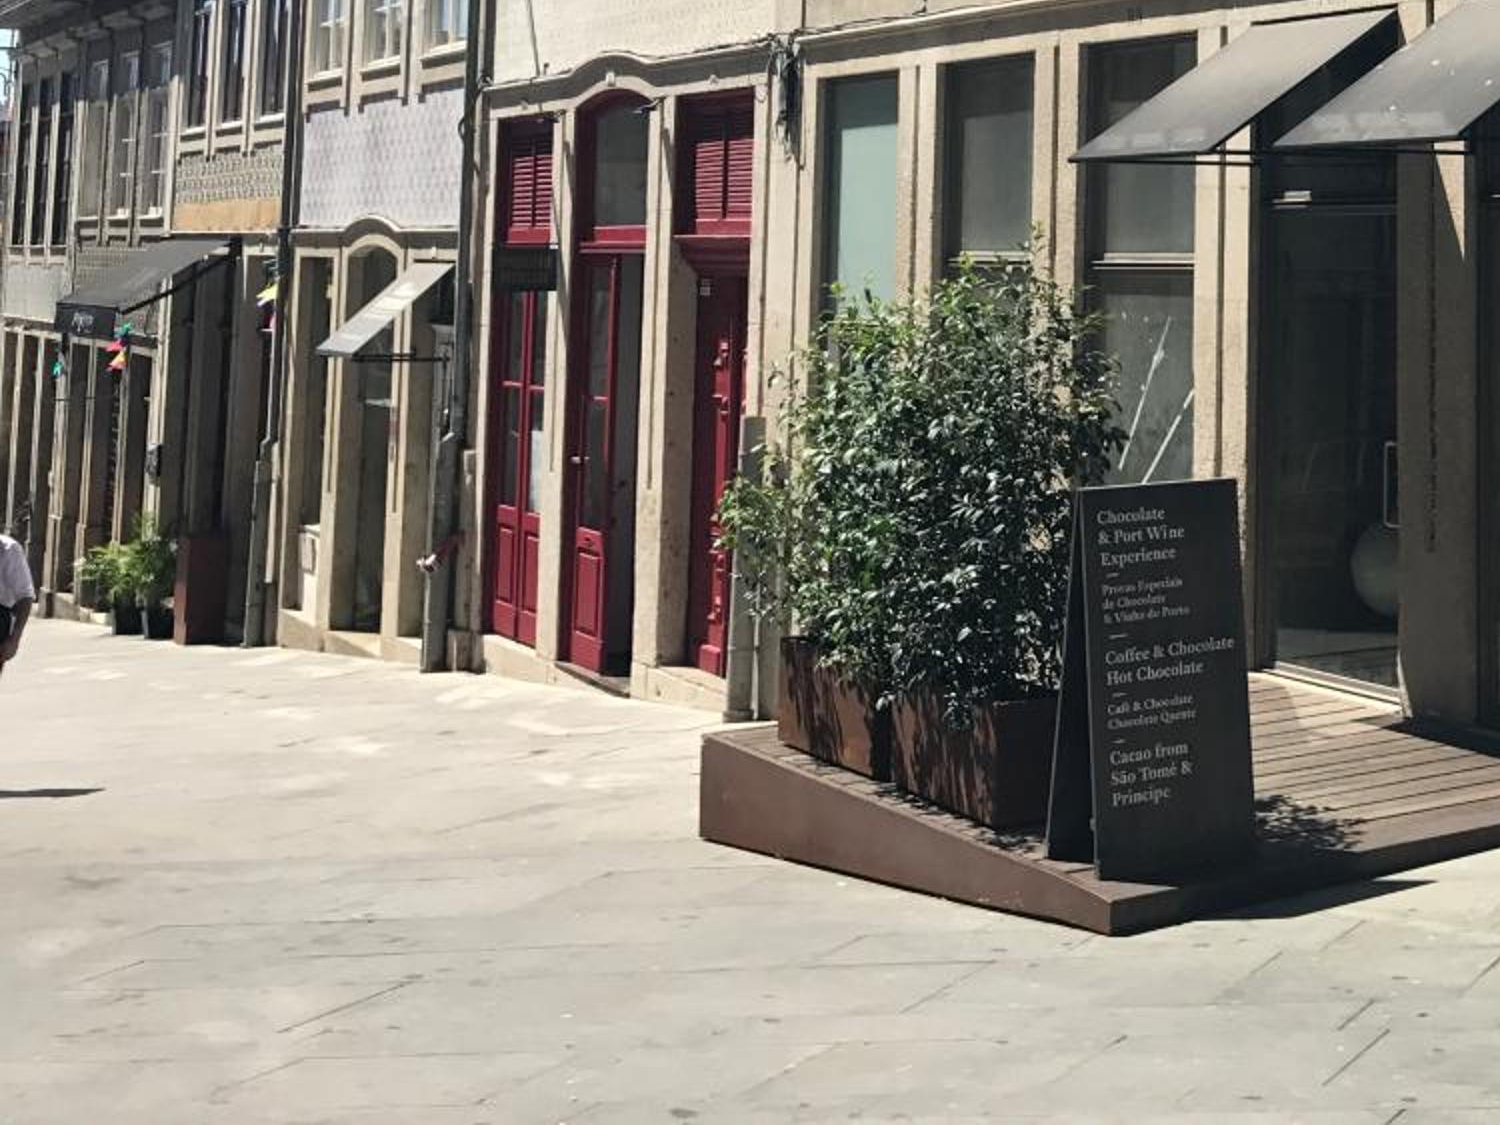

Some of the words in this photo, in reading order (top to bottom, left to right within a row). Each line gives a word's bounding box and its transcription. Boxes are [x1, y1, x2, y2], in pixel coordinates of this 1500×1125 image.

[1097, 507, 1165, 525] Chocolate
[1098, 529, 1110, 544] &
[1114, 527, 1143, 543] Port
[1147, 524, 1184, 540] Wine
[1100, 547, 1177, 568] Experience
[1117, 593, 1165, 608] Chocolate
[1162, 605, 1190, 618] Porto
[1105, 646, 1149, 665] Coffee
[1153, 644, 1165, 658] &
[1168, 636, 1235, 656] Chocolate
[1106, 669, 1133, 686] Hot
[1136, 660, 1204, 681] Chocolate
[1144, 693, 1193, 709] Chocolate
[1107, 714, 1158, 730] Chocolate
[1160, 708, 1196, 724] Quente
[1110, 748, 1151, 766] Cacao
[1155, 742, 1188, 758] from
[1111, 768, 1136, 786] São
[1140, 762, 1177, 781] Tomé
[1181, 760, 1193, 775] &
